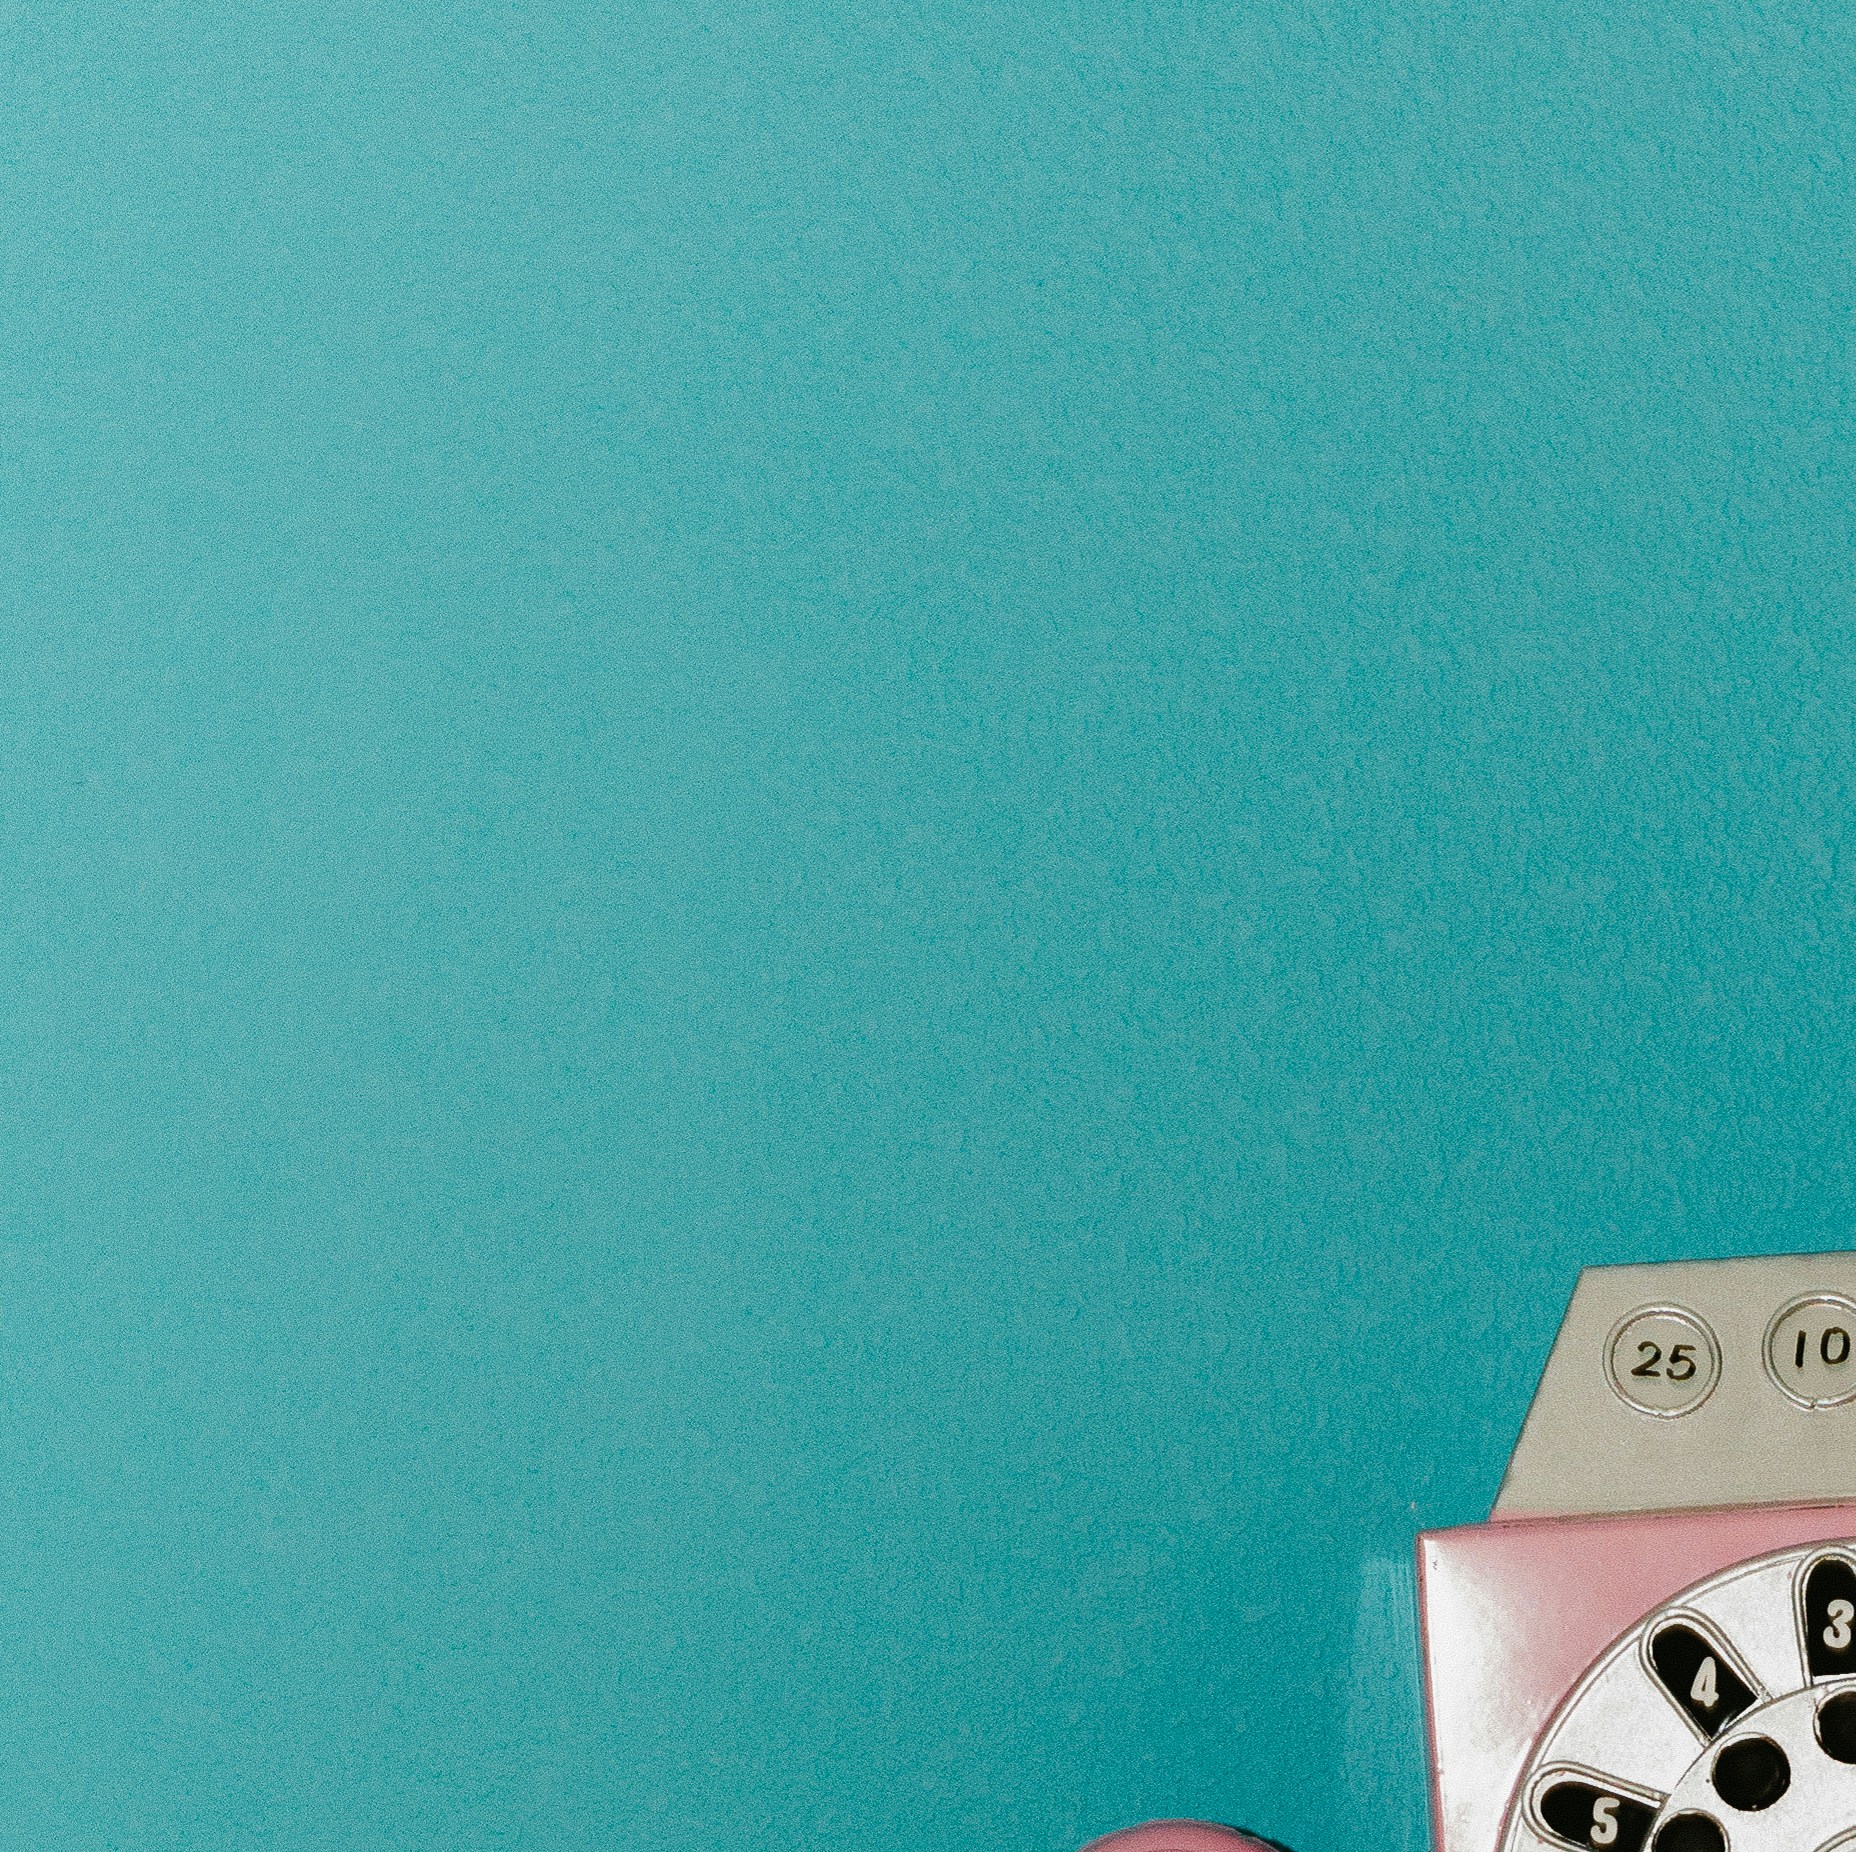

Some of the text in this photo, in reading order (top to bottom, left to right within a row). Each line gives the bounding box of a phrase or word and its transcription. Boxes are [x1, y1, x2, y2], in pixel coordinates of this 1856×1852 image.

[1630, 1341, 1697, 1382] 25
[1794, 1326, 1851, 1368] 10
[1823, 1600, 1853, 1648] 3
[1690, 1656, 1720, 1706] 4
[1590, 1797, 1620, 1843] 5
